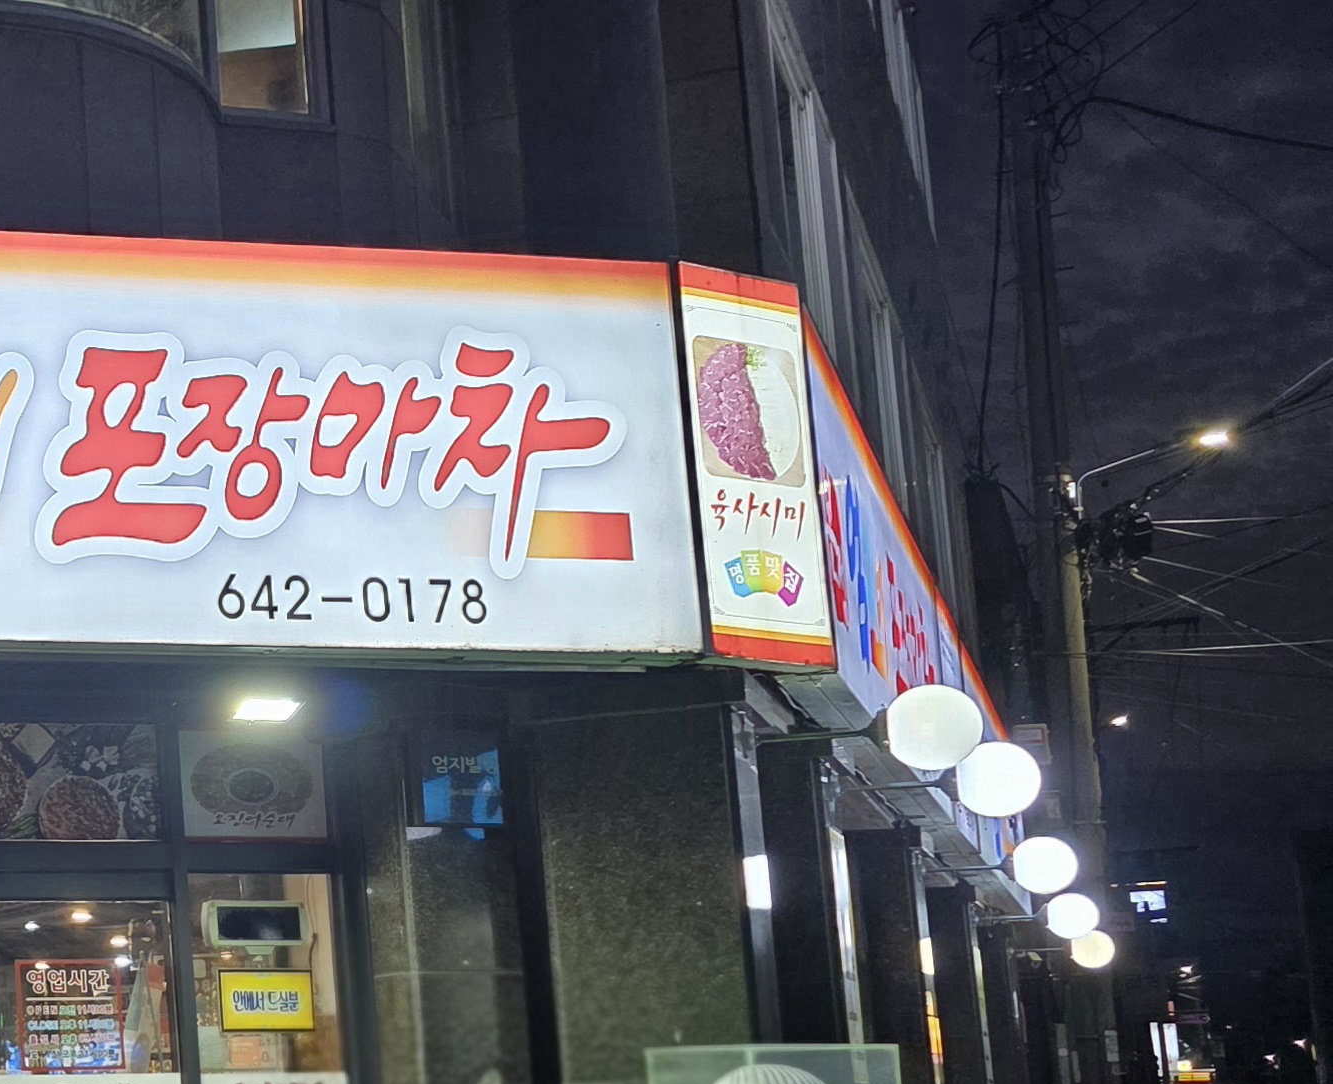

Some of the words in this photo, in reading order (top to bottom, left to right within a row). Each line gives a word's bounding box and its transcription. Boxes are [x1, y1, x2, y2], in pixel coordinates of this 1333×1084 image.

[52, 341, 612, 563] 포장마차
[710, 489, 806, 540] 육사시미
[217, 575, 490, 625] 642-0178
[213, 812, 296, 830] 오징어순대
[26, 969, 109, 993] 영업시간
[26, 1005, 58, 1015] OPEN
[233, 990, 265, 1012] 안에서
[268, 990, 300, 1012] 드실분
